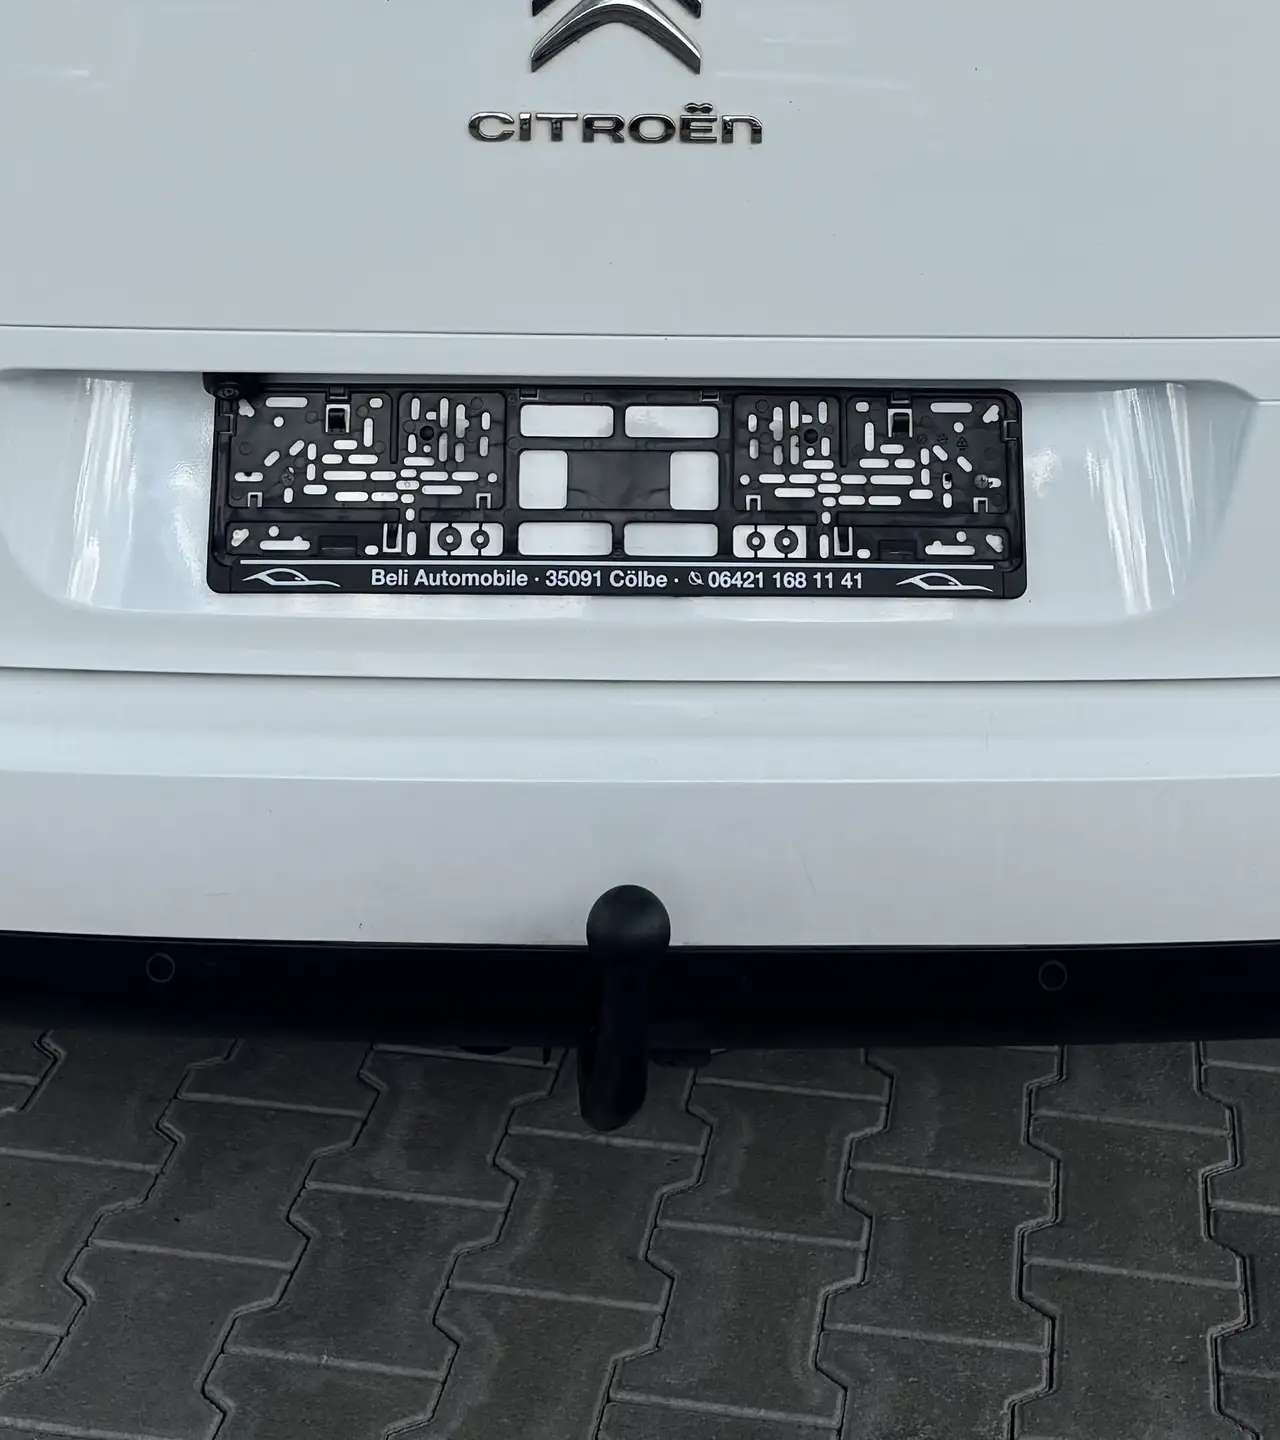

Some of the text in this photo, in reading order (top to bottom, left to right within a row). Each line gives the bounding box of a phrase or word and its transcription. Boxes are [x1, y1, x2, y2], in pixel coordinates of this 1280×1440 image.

[370, 568, 864, 590] Beli Automobile 35091 Cölbe 06421 168 11 41
